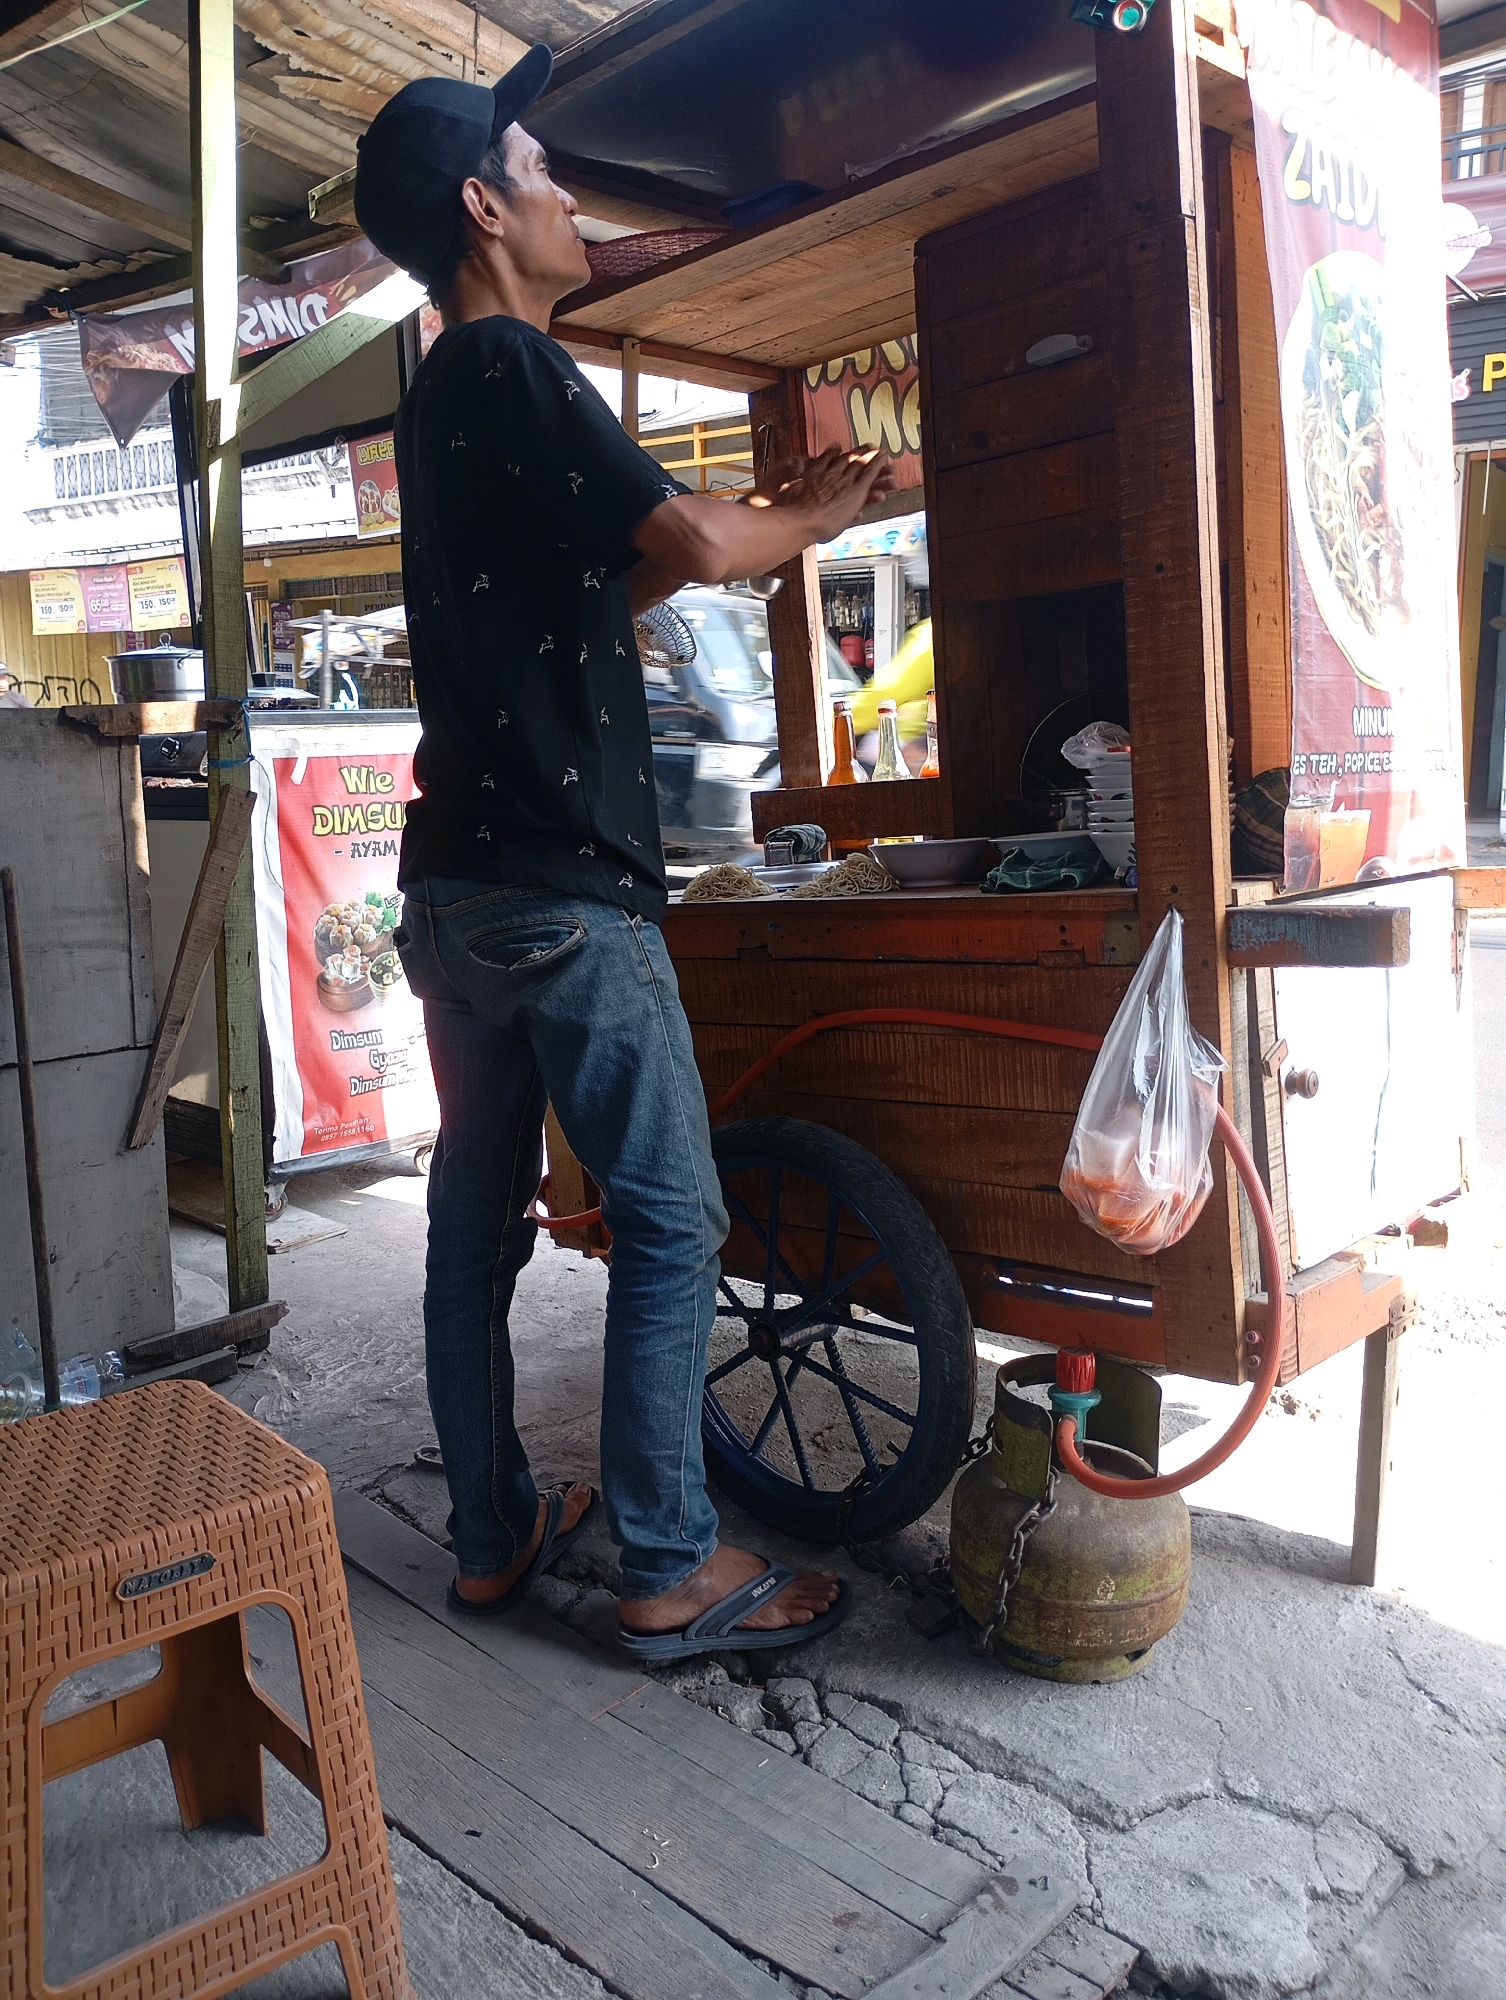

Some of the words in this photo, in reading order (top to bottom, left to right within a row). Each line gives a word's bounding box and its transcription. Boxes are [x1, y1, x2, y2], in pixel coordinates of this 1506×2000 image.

[1280, 107, 1387, 242] ZAID
[1292, 754, 1307, 776] ES
[340, 764, 395, 795] Wie
[312, 801, 407, 836] DIMSU
[351, 839, 398, 859] AYAM
[330, 1029, 384, 1051] Dimsum
[350, 1073, 397, 1097] Dimsum
